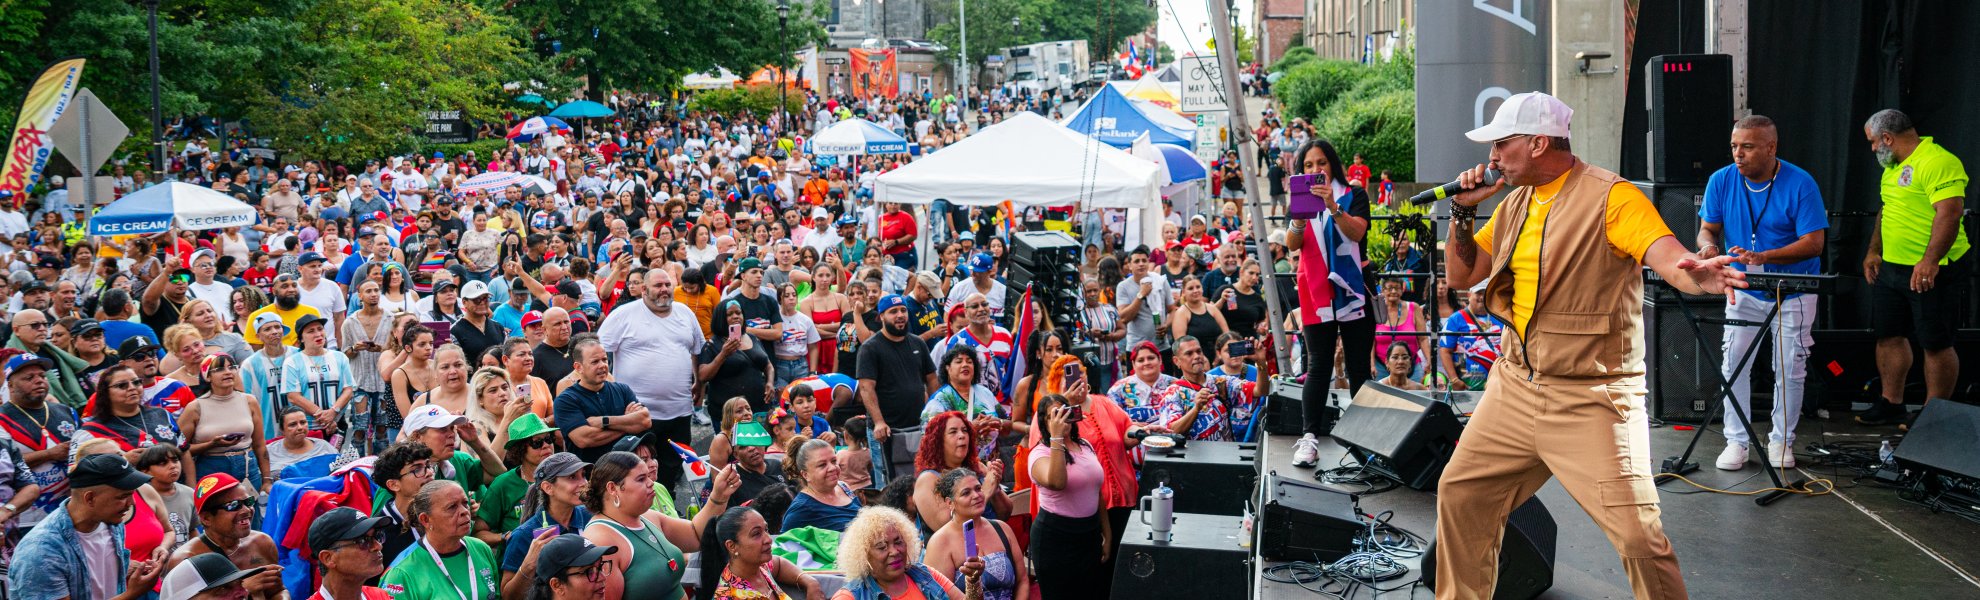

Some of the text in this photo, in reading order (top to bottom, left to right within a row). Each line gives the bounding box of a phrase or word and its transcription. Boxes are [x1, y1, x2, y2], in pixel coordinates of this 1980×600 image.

[1188, 84, 1205, 92] MAY
[1184, 97, 1204, 105] FULL
[1208, 96, 1226, 104] LAN
[440, 124, 452, 133] PARK
[186, 215, 248, 226] CE CREAM
[98, 220, 166, 232] ICE CREAM
[918, 310, 938, 326] INDIANA
